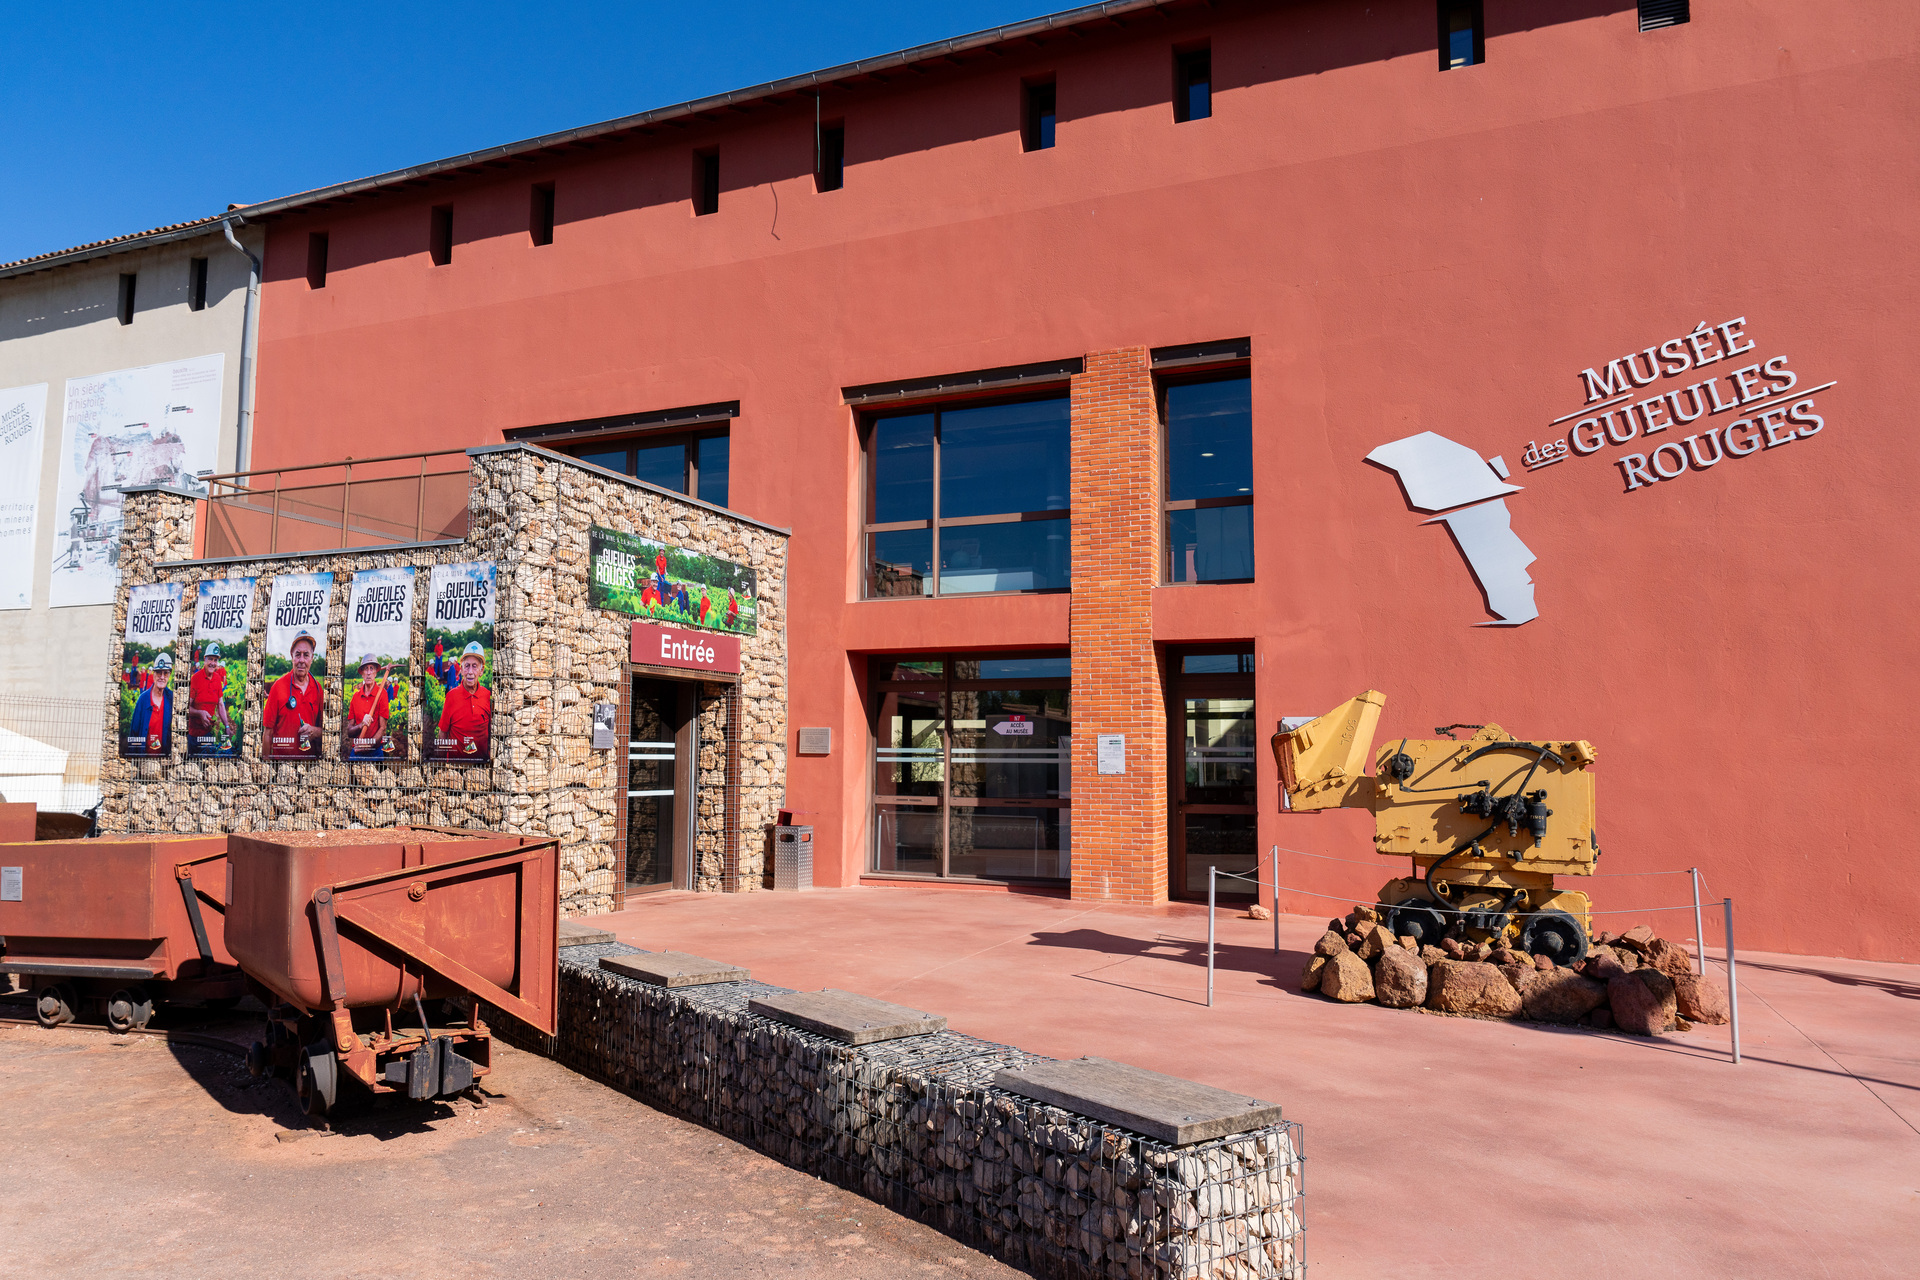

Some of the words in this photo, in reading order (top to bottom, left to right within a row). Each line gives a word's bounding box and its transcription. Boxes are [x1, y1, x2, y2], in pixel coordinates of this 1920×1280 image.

[1582, 316, 1756, 402] MUSÉE
[68, 386, 79, 398] Un
[82, 382, 105, 396] siècle
[1, 402, 26, 424] MUSÉE
[67, 410, 97, 424] minière
[1525, 437, 1569, 464] des
[1572, 355, 1798, 454] GUEULES
[4, 422, 33, 446] ROUGES
[1618, 399, 1825, 489] ROUGES
[603, 548, 636, 570] GUEULES
[596, 562, 635, 590] ROUGES
[277, 599, 286, 608] LES
[285, 589, 325, 606] GUEULES
[357, 596, 366, 604] LES
[365, 585, 406, 602] GUEULES
[436, 591, 446, 600] LES
[446, 580, 489, 598] GUEULES
[140, 598, 176, 615] GUEULES
[210, 594, 248, 610] GUEULES
[356, 602, 404, 623] ROUGES
[436, 597, 487, 620] ROUGES
[133, 614, 172, 634] ROUGES
[203, 610, 244, 630] ROUGES
[276, 605, 322, 627] ROUGES
[661, 633, 715, 664] Entrée
